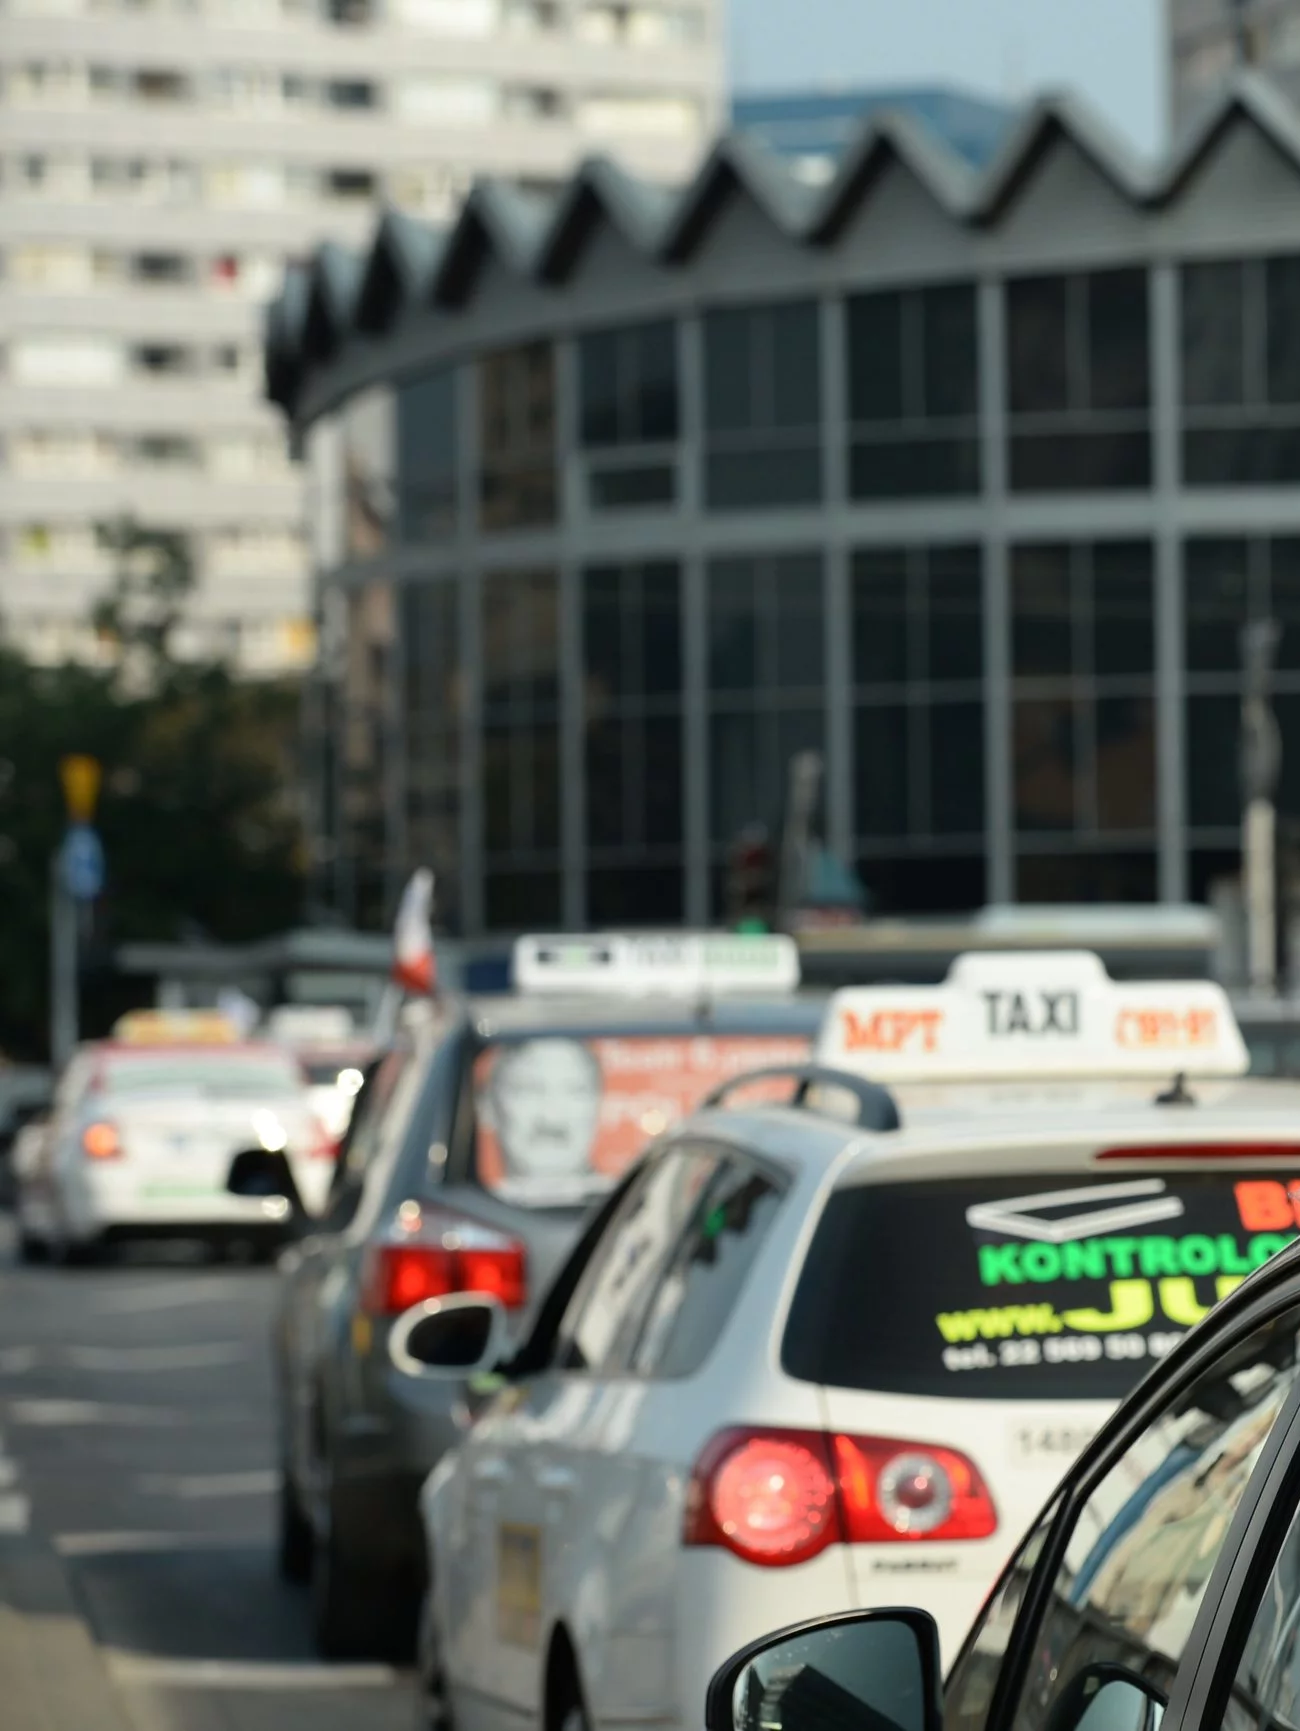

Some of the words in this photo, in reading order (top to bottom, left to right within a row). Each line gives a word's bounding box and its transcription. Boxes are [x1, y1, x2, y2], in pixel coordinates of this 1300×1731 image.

[840, 1008, 944, 1052] MPT
[983, 991, 1080, 1037] TAXI
[979, 1233, 1299, 1287] KONTROLO
[935, 1276, 1247, 1343] www.JU
